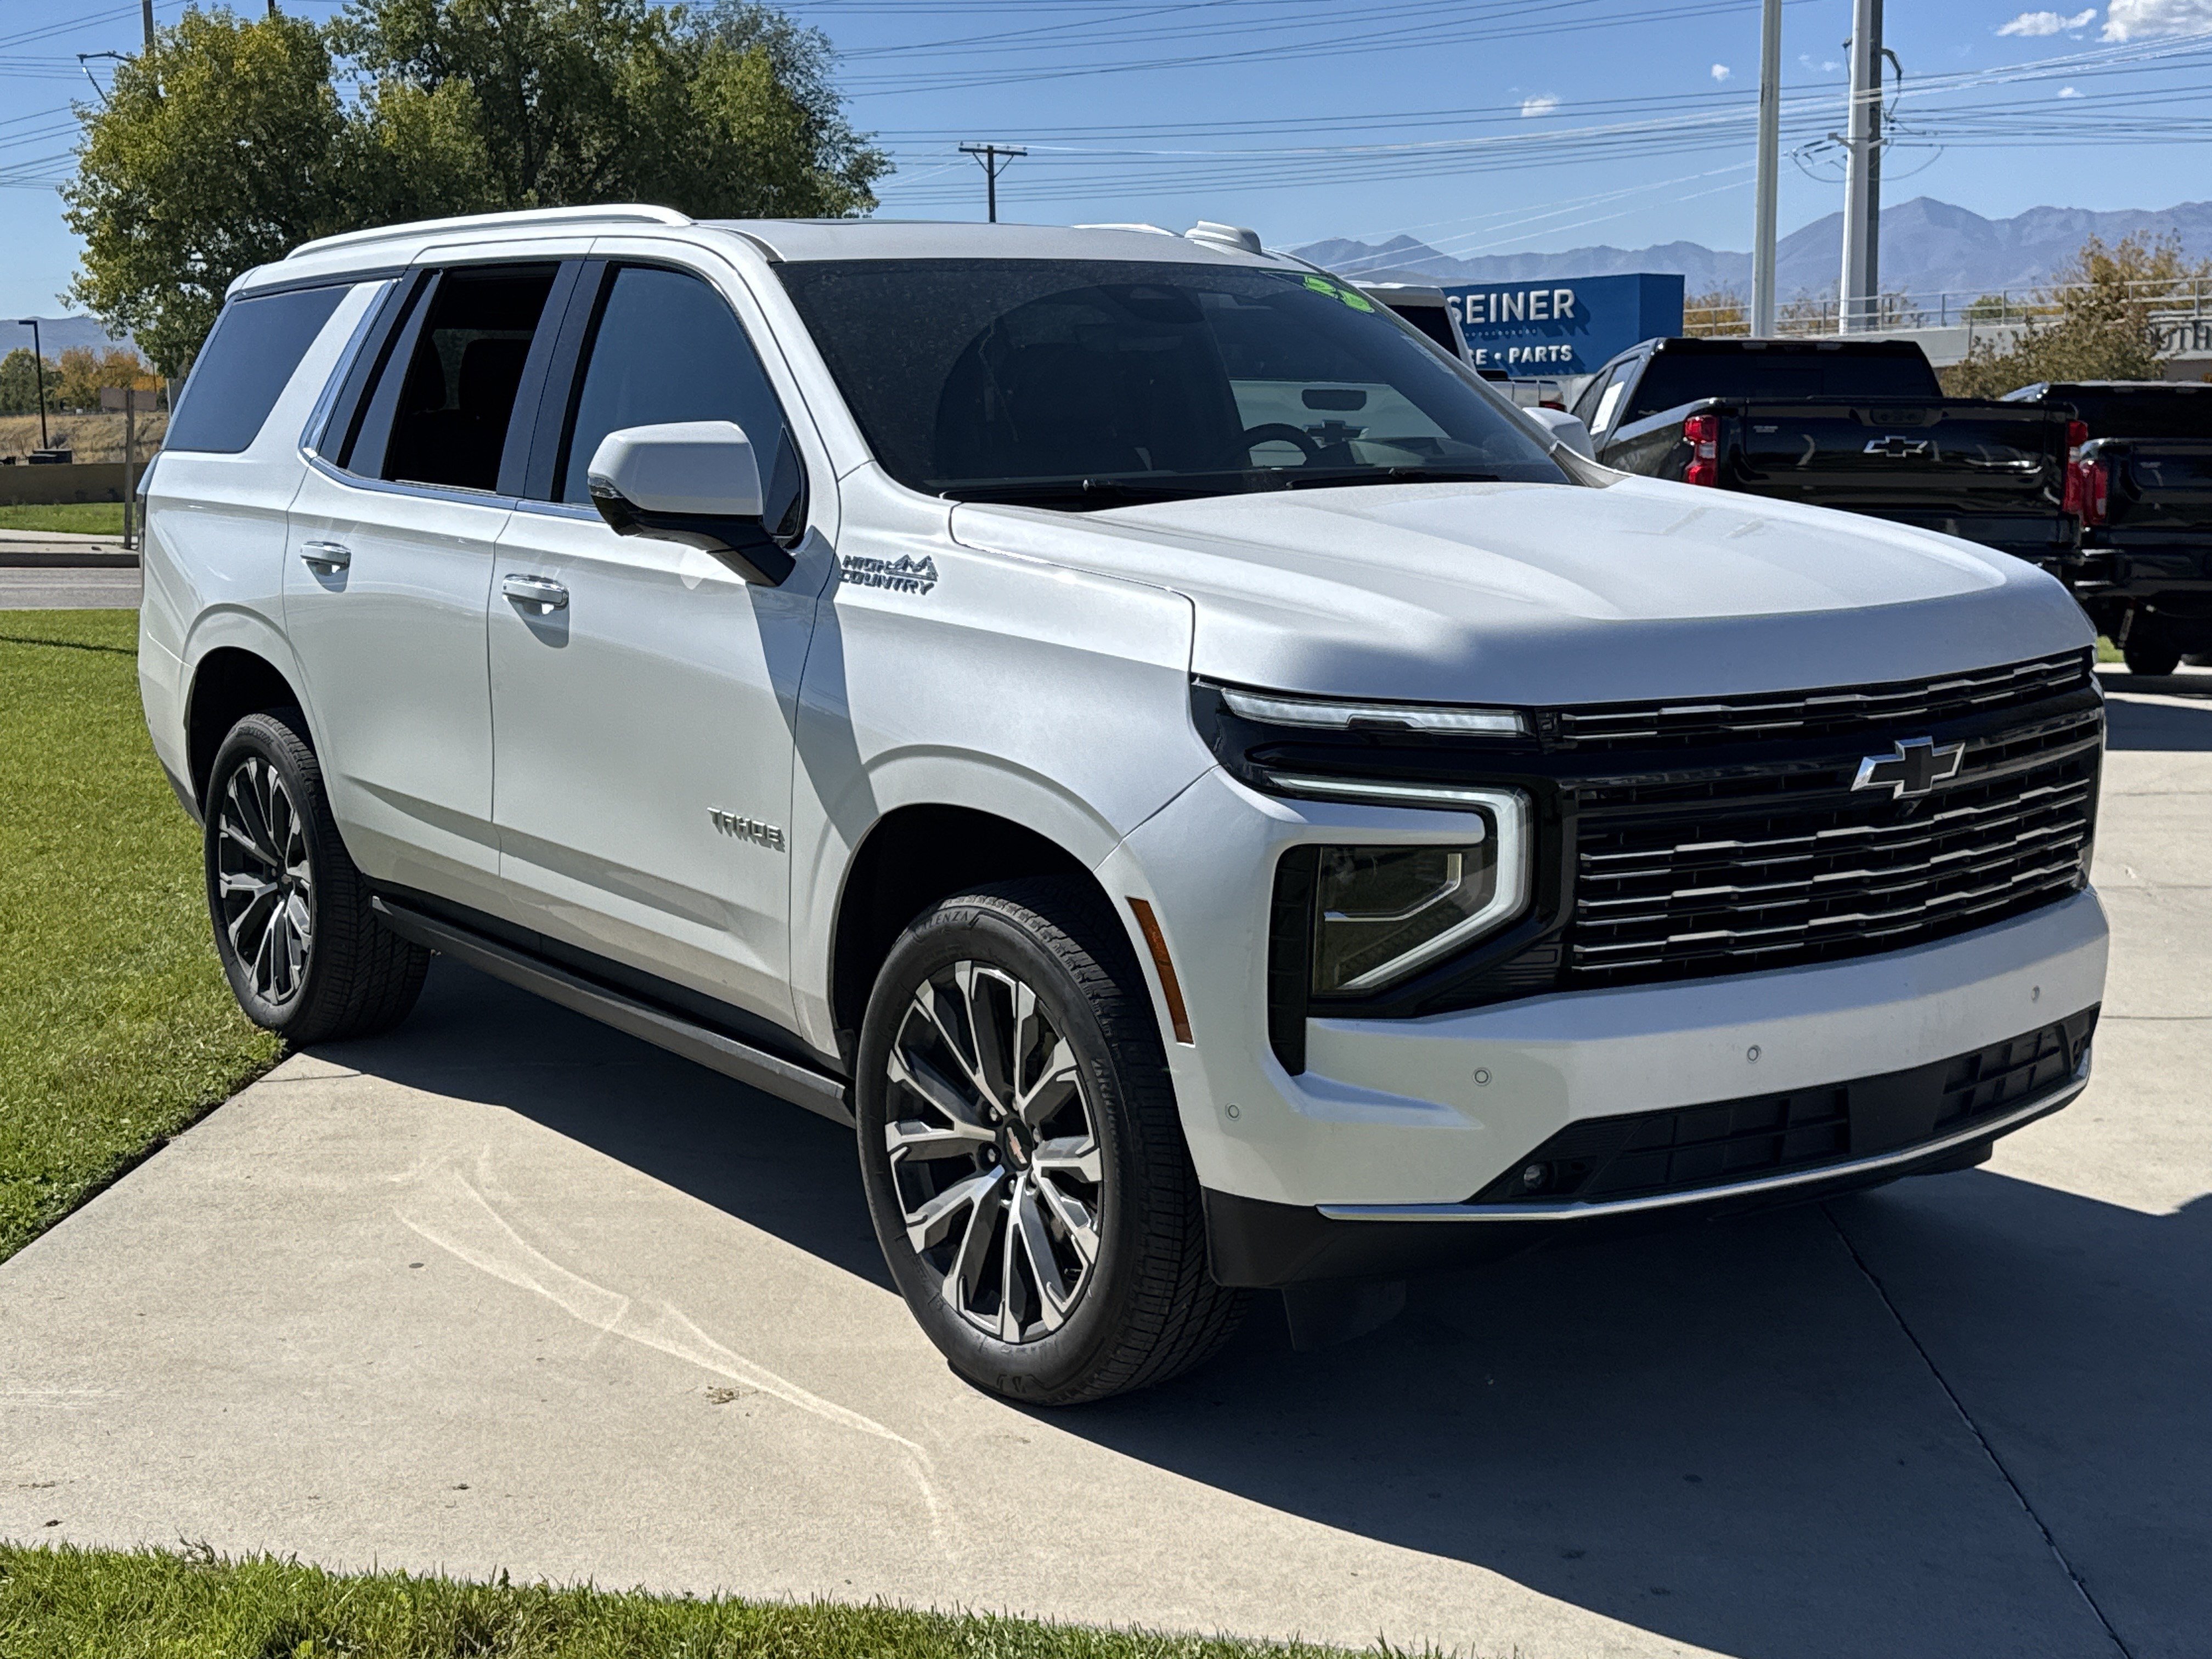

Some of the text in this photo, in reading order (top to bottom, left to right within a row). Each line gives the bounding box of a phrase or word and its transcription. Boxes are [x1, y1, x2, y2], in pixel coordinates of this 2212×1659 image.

[1447, 289, 1575, 324] SEINER
[1509, 345, 1573, 364] PARTS
[839, 569, 934, 595] COUNTRY
